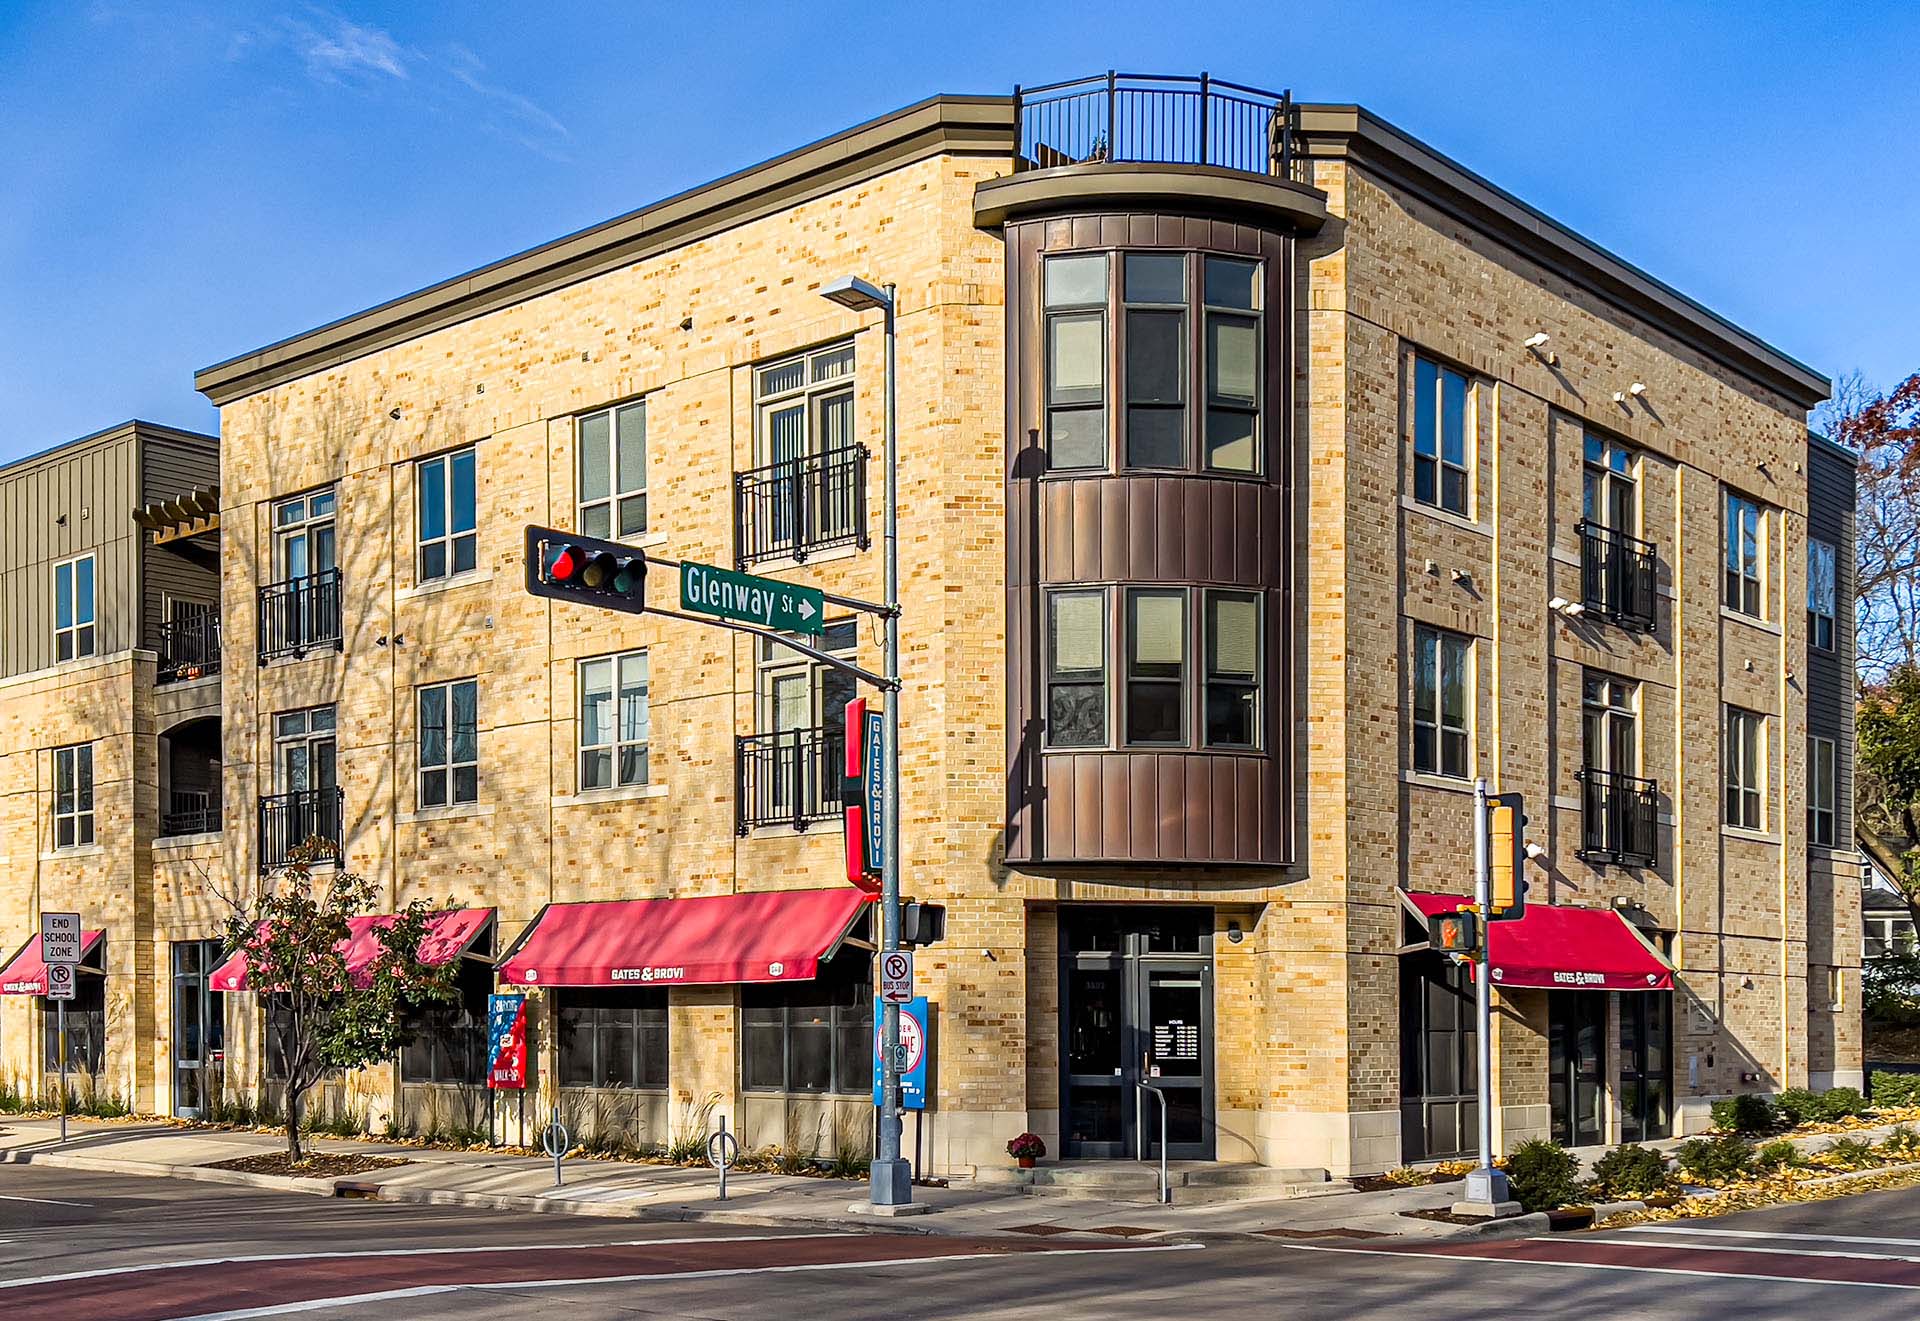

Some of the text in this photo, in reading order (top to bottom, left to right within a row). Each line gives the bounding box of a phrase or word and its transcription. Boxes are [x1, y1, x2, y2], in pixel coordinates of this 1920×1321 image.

[687, 566, 793, 625] Glenway St
[52, 918, 69, 929] END
[44, 932, 78, 943] SCHOOL
[50, 946, 73, 957] ZONE
[883, 981, 910, 990] BUS STOP
